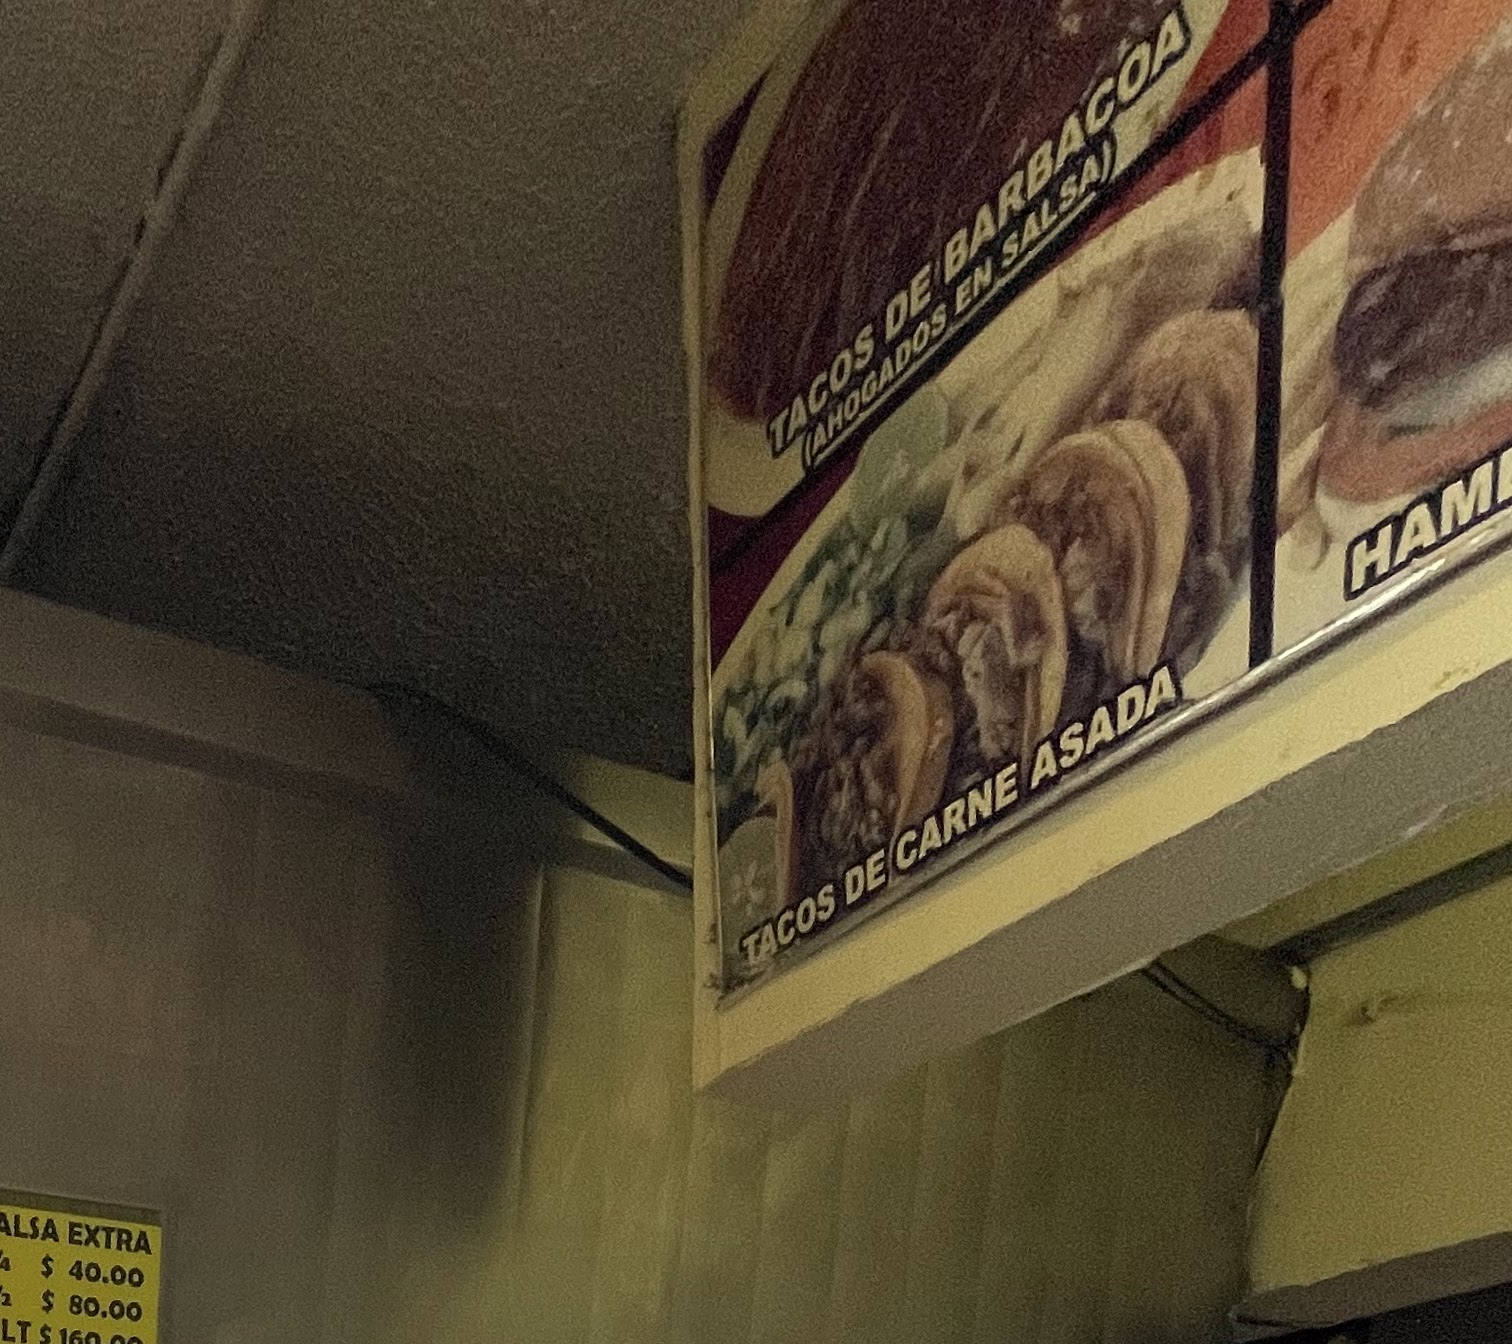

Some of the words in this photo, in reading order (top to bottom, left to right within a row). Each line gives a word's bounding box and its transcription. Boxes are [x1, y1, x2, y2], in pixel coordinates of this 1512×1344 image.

[770, 325, 874, 458] TACOS
[886, 262, 933, 344] DE
[944, 10, 1186, 283] BARBACOA
[803, 303, 947, 467] (AHOGADOS
[956, 261, 993, 314] EN
[1002, 140, 1113, 266] SALSA)
[741, 885, 836, 967] TACOS
[845, 850, 887, 903] DE
[895, 764, 1020, 871] CARNE
[1031, 666, 1177, 789] ASADA
[68, 1220, 153, 1255] EXTRA
[68, 1260, 145, 1288] 40.00
[69, 1294, 143, 1322] 80.00
[1, 1318, 32, 1343] LT
